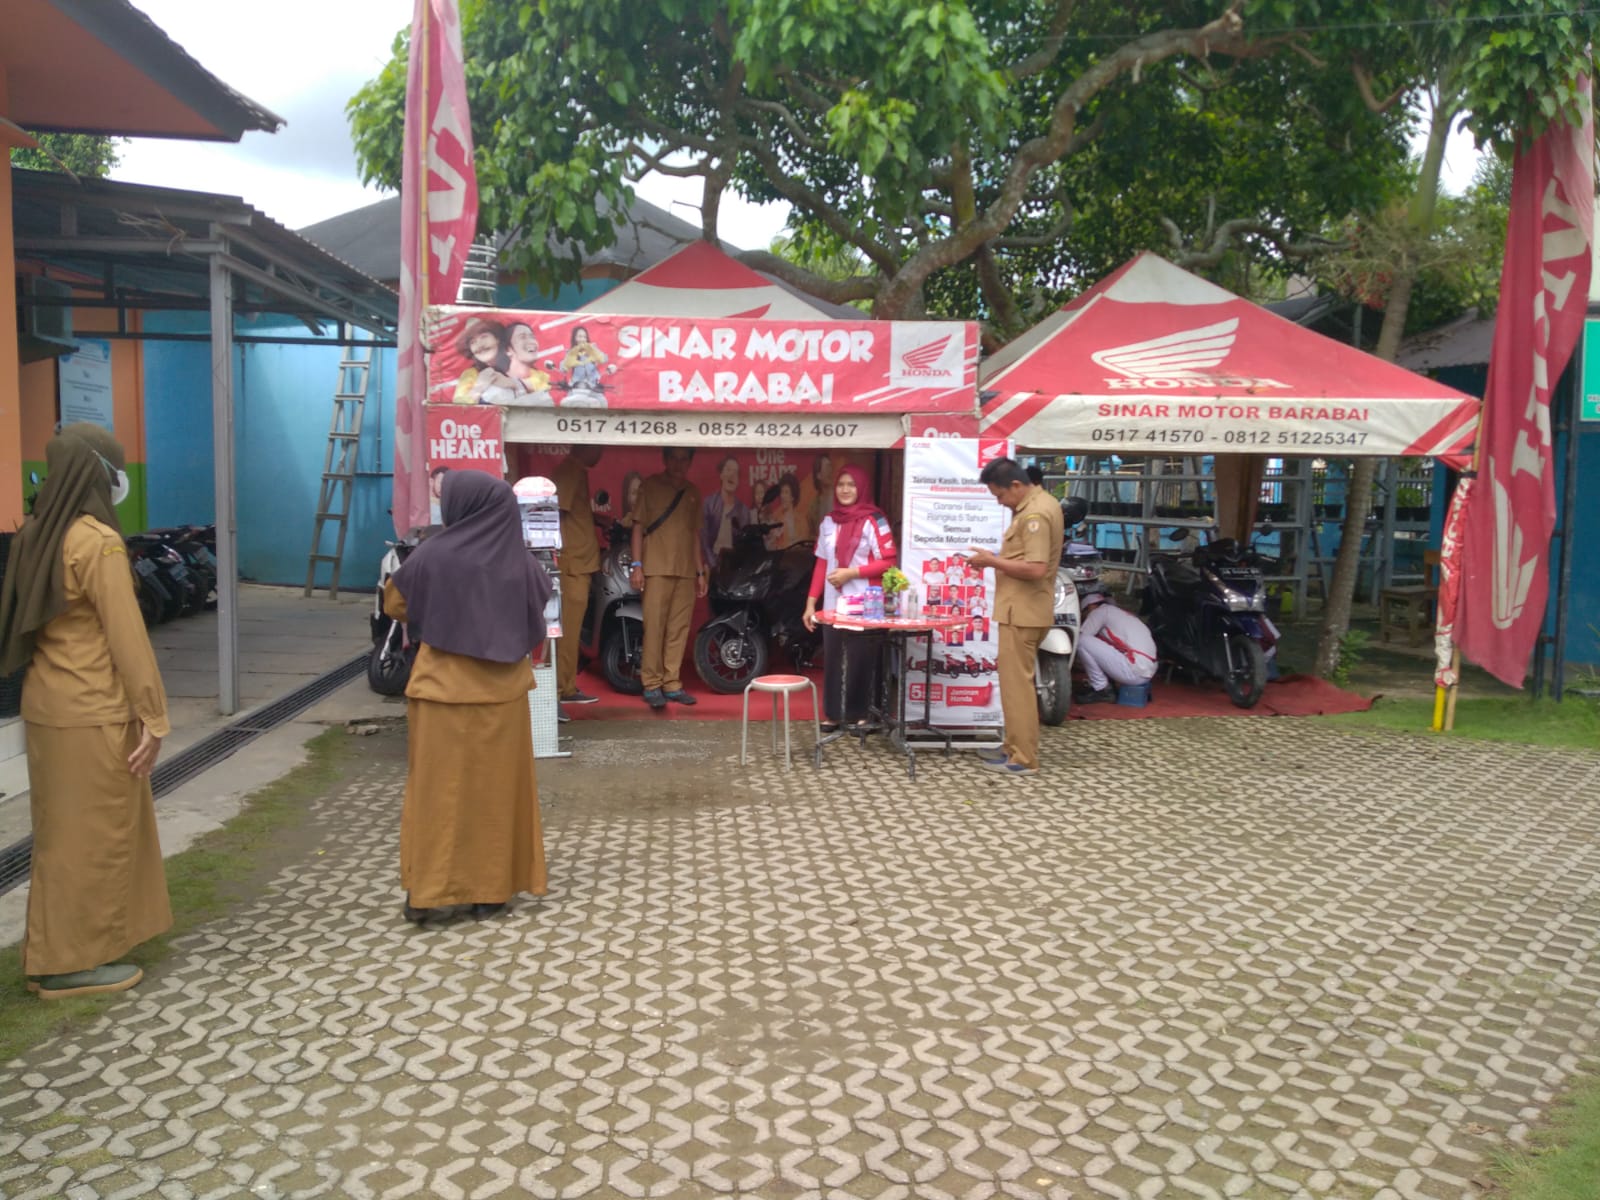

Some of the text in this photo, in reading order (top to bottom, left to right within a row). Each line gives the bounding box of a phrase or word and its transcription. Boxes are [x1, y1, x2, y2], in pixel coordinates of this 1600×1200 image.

[618, 326, 875, 363] SINAR MOTOR
[902, 369, 952, 377] HONDA
[658, 369, 834, 404] BARABAI
[1103, 378, 1294, 389] HONDA
[1098, 403, 1369, 421] SINAR MOTOR BARABAI
[440, 419, 482, 439] One
[557, 418, 607, 433] 0517
[614, 420, 677, 435] 41268
[698, 422, 747, 436] 0852
[754, 422, 803, 437] 4824
[810, 423, 859, 438] 4607
[1091, 428, 1138, 442] 0517
[1145, 429, 1204, 443] 41570
[1224, 430, 1270, 444] 0812
[1277, 431, 1369, 446] 51225347
[430, 439, 500, 459] HEART.
[913, 535, 944, 544] Sepeda
[971, 536, 998, 544] Honda
[911, 685, 922, 699] 5
